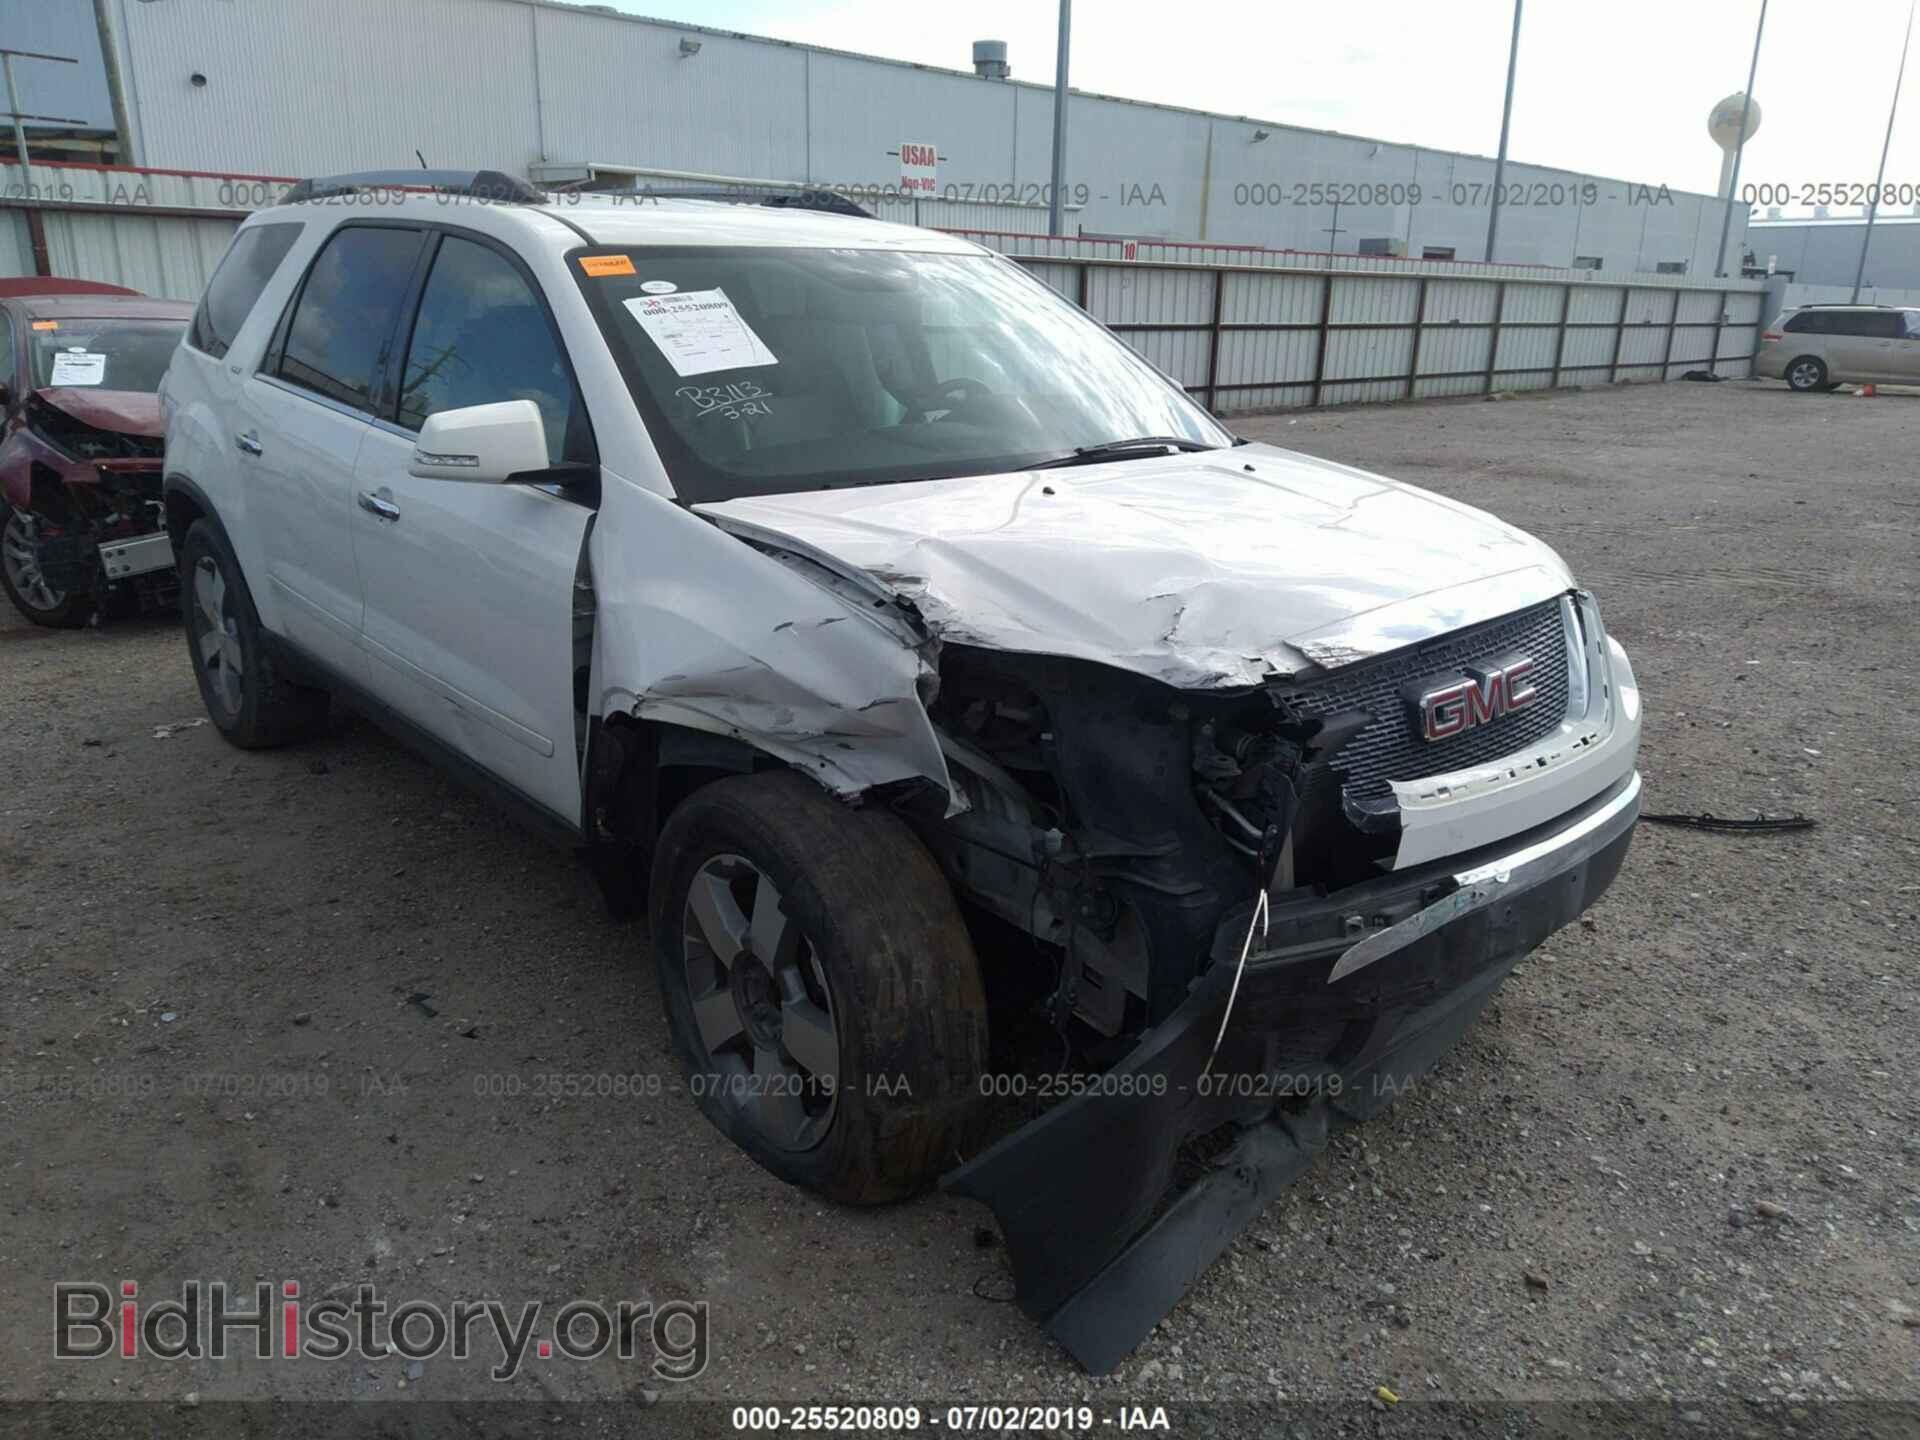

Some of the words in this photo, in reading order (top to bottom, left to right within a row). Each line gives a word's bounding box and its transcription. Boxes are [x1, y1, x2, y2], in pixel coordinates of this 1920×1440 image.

[901, 144, 935, 167] USAA
[1124, 243, 1136, 260] 10
[675, 381, 762, 410] B3113
[1420, 657, 1537, 742] GMC
